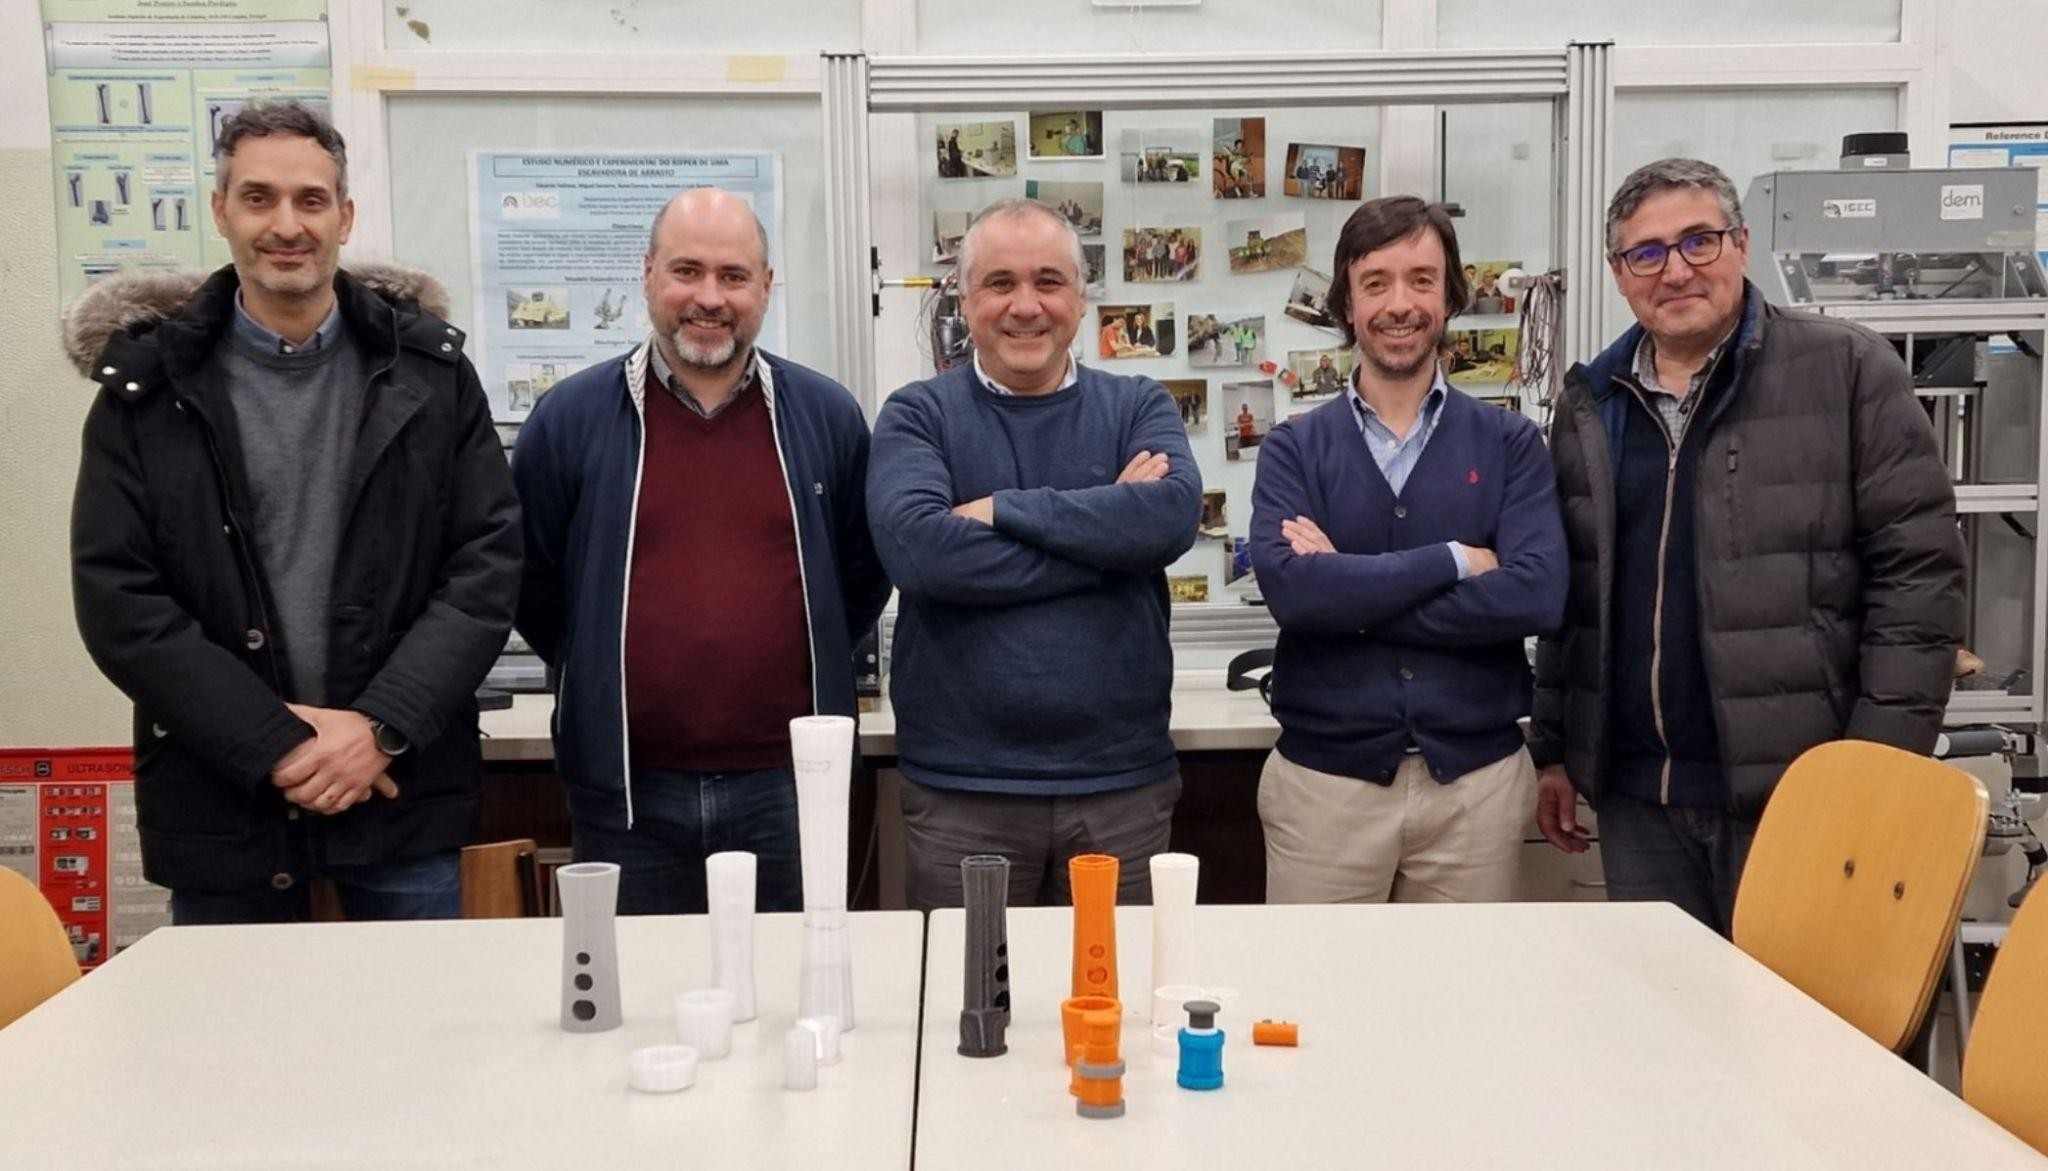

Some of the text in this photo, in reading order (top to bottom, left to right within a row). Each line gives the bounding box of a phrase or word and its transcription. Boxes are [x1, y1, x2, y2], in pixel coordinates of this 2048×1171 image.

[1985, 130, 2041, 140] Reference
[522, 158, 552, 166] ESTUDO
[554, 157, 594, 166] NUMÉRICO
[603, 158, 656, 166] EXPERIMENTAL
[659, 158, 671, 166] DO
[700, 158, 709, 166] DE
[711, 158, 729, 166] UMA
[577, 168, 627, 178] ESCAVADORA
[628, 168, 638, 178] DE
[1942, 190, 1981, 207] dem
